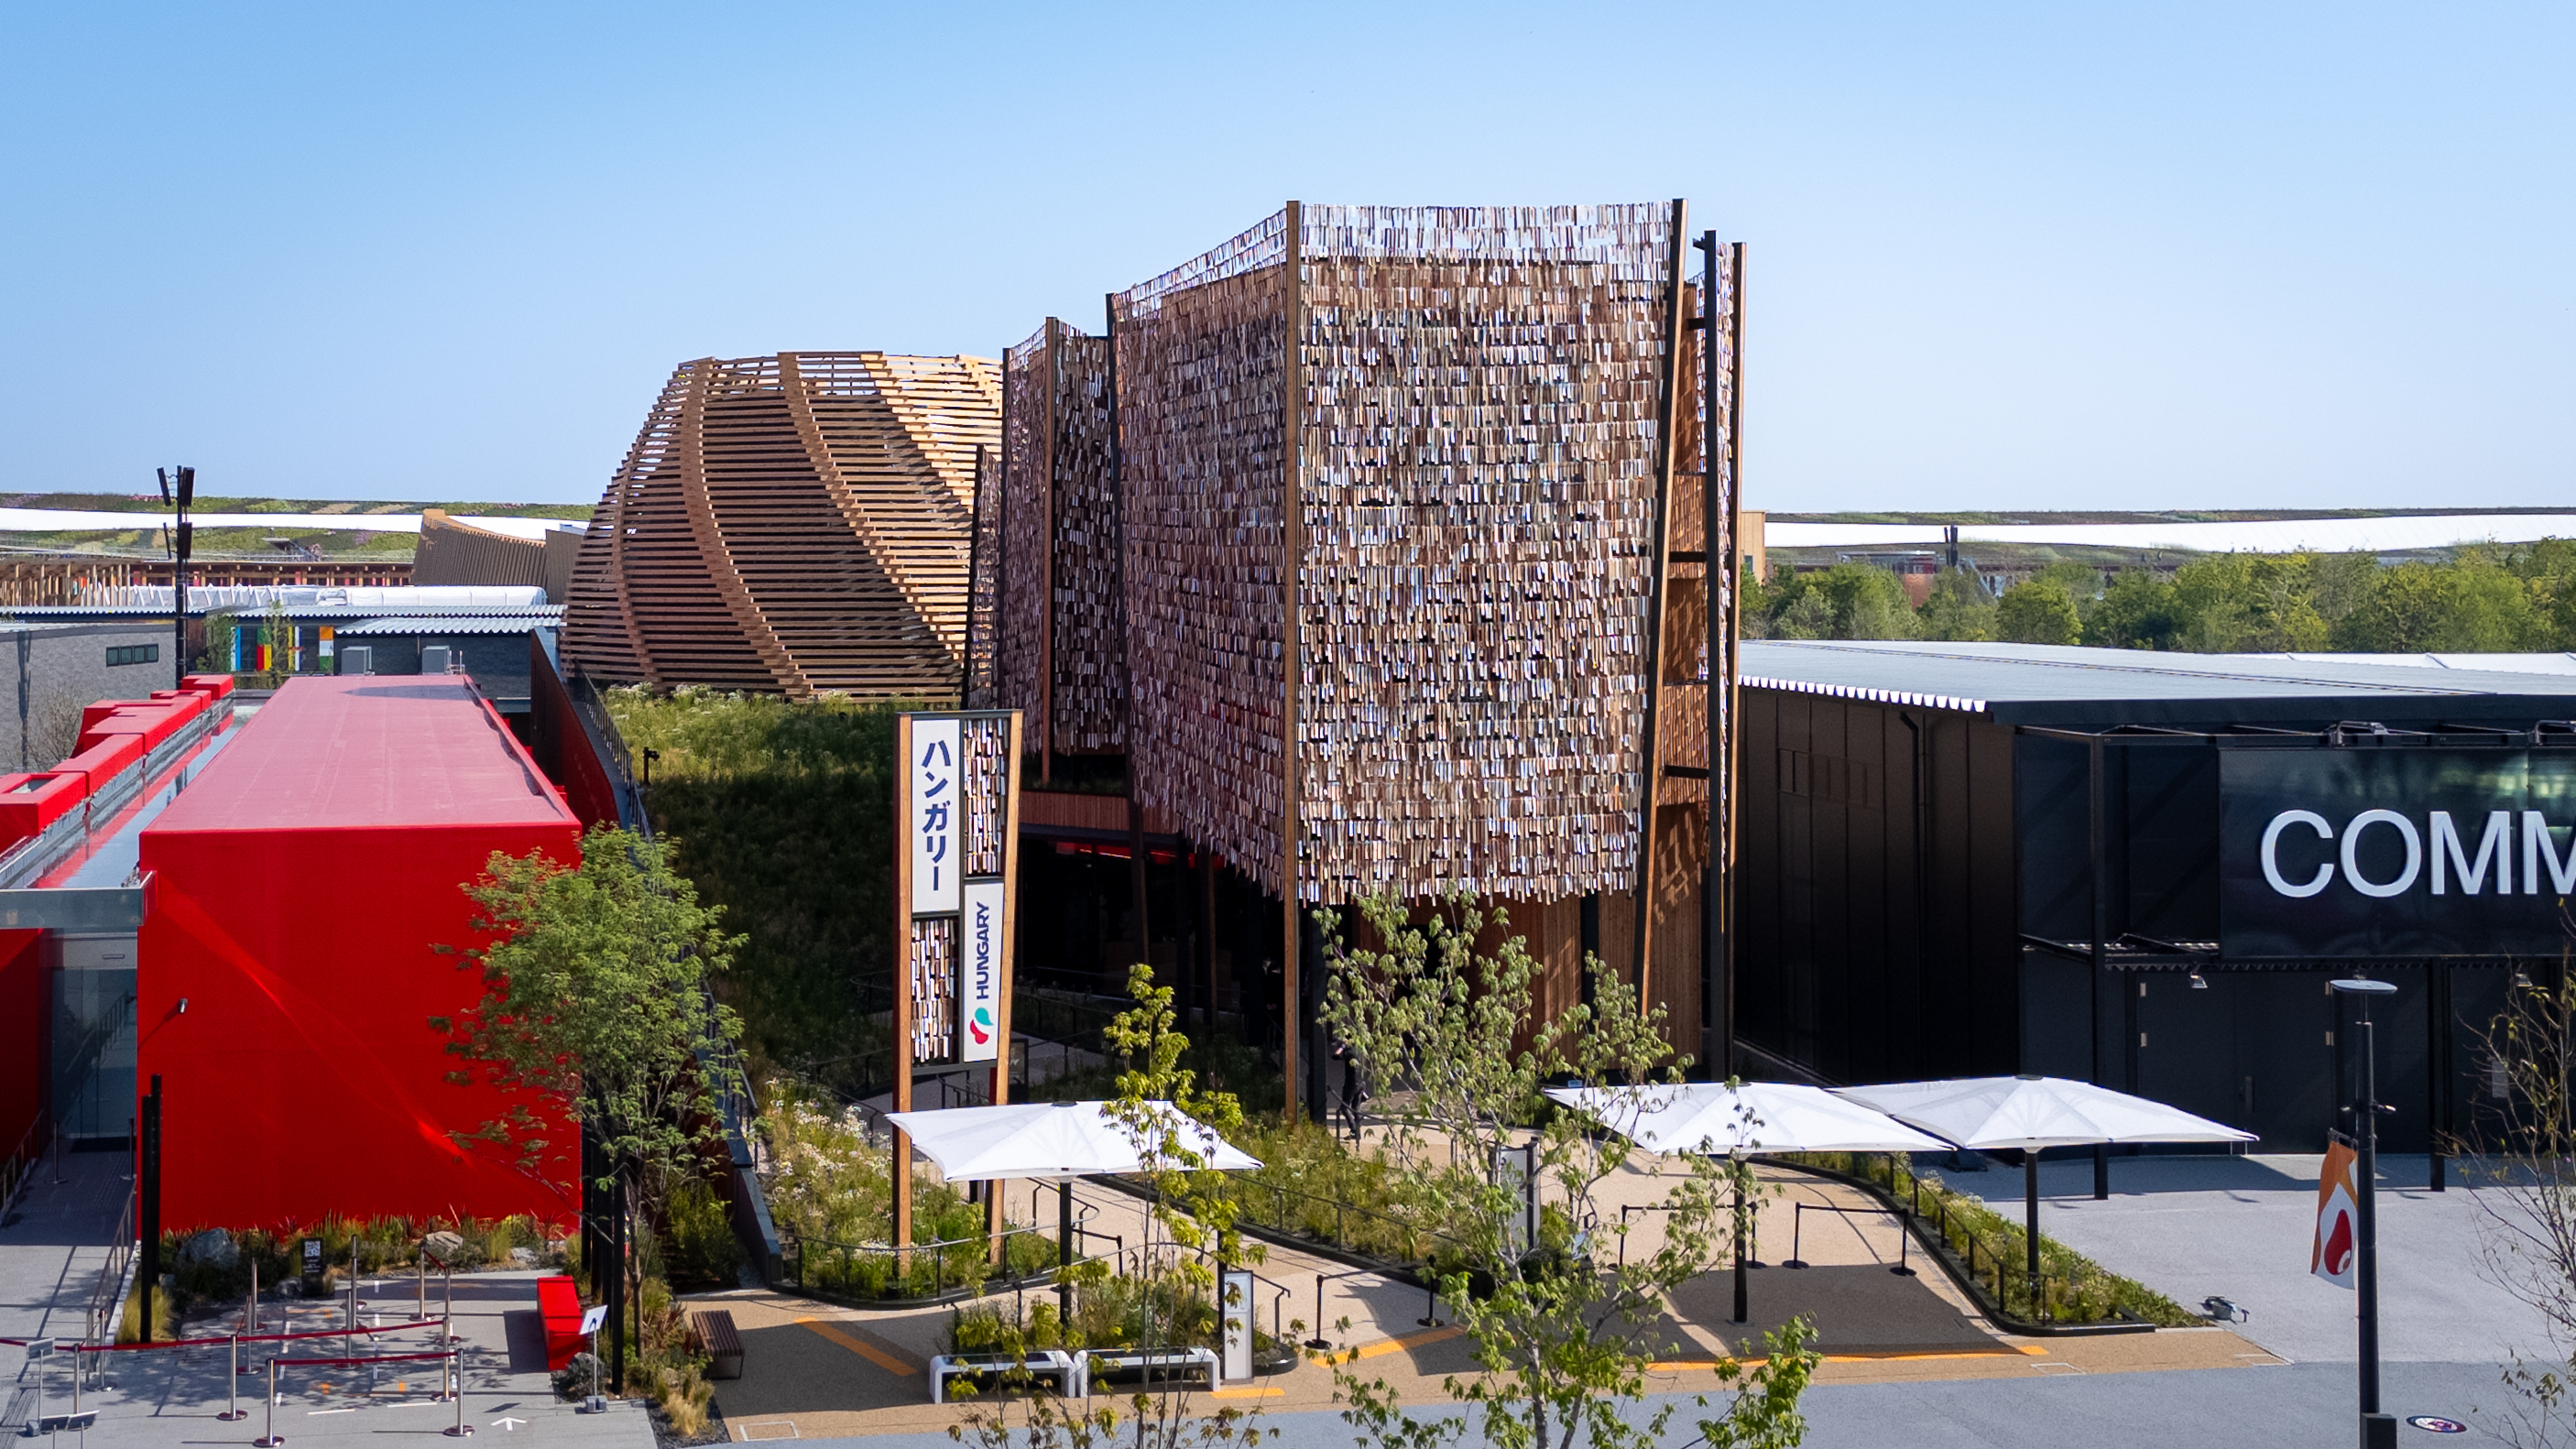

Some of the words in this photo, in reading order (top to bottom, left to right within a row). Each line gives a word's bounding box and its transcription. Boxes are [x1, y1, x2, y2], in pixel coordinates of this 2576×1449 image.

[921, 739, 952, 891] ハンガリー
[976, 901, 989, 1000] HUNGARY
